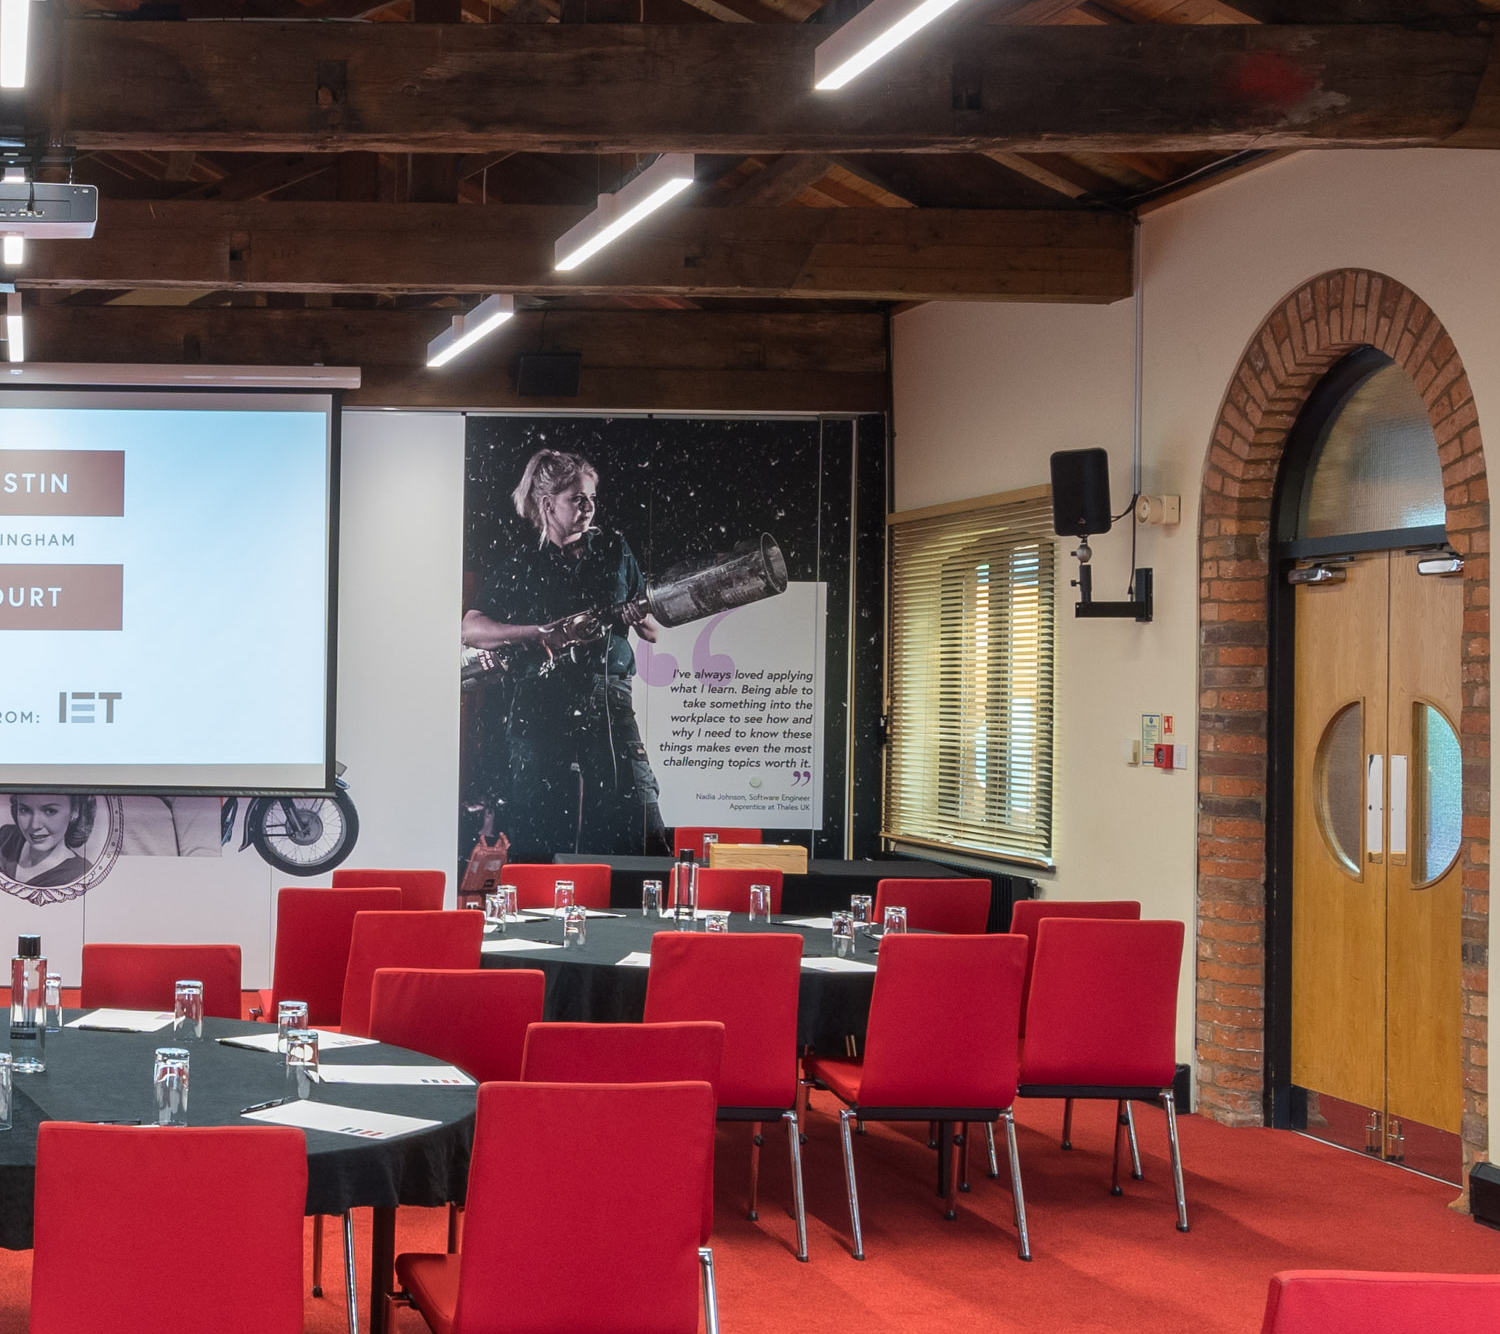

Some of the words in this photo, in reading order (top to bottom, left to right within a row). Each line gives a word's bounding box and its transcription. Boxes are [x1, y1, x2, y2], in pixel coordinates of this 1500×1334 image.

[672, 669, 691, 679] I've
[694, 669, 731, 682] always
[734, 670, 764, 680] loved
[767, 670, 814, 682] applying
[670, 683, 697, 694] what
[700, 684, 705, 694] I
[708, 684, 737, 694] learn.
[741, 685, 772, 697] Being
[774, 685, 798, 695] able
[801, 686, 813, 695] to
[58, 692, 122, 724] IET
[683, 698, 707, 708] take
[709, 699, 767, 711] something
[769, 700, 791, 709] into
[795, 700, 813, 710] the
[670, 713, 726, 726] workplace
[729, 714, 741, 723] to
[744, 716, 763, 724] see
[766, 714, 789, 724] how
[792, 714, 813, 724] and
[671, 727, 694, 740] why
[697, 727, 702, 738] I
[704, 728, 732, 738] need
[734, 729, 747, 738] to
[750, 728, 779, 739] know
[782, 728, 813, 739] these
[659, 741, 693, 754] things
[696, 742, 731, 753] makes
[734, 745, 759, 753] even
[763, 743, 781, 754] the
[784, 744, 812, 754] most
[663, 756, 724, 770] challenging
[728, 758, 761, 770] topics
[764, 758, 796, 768] worth
[800, 759, 811, 768] it.
[695, 793, 716, 801] Nadia
[717, 793, 747, 802] Johnson,
[749, 793, 780, 802] Software
[781, 794, 811, 803] Engineer
[729, 803, 766, 811] Apprentice
[777, 803, 798, 811] Thales
